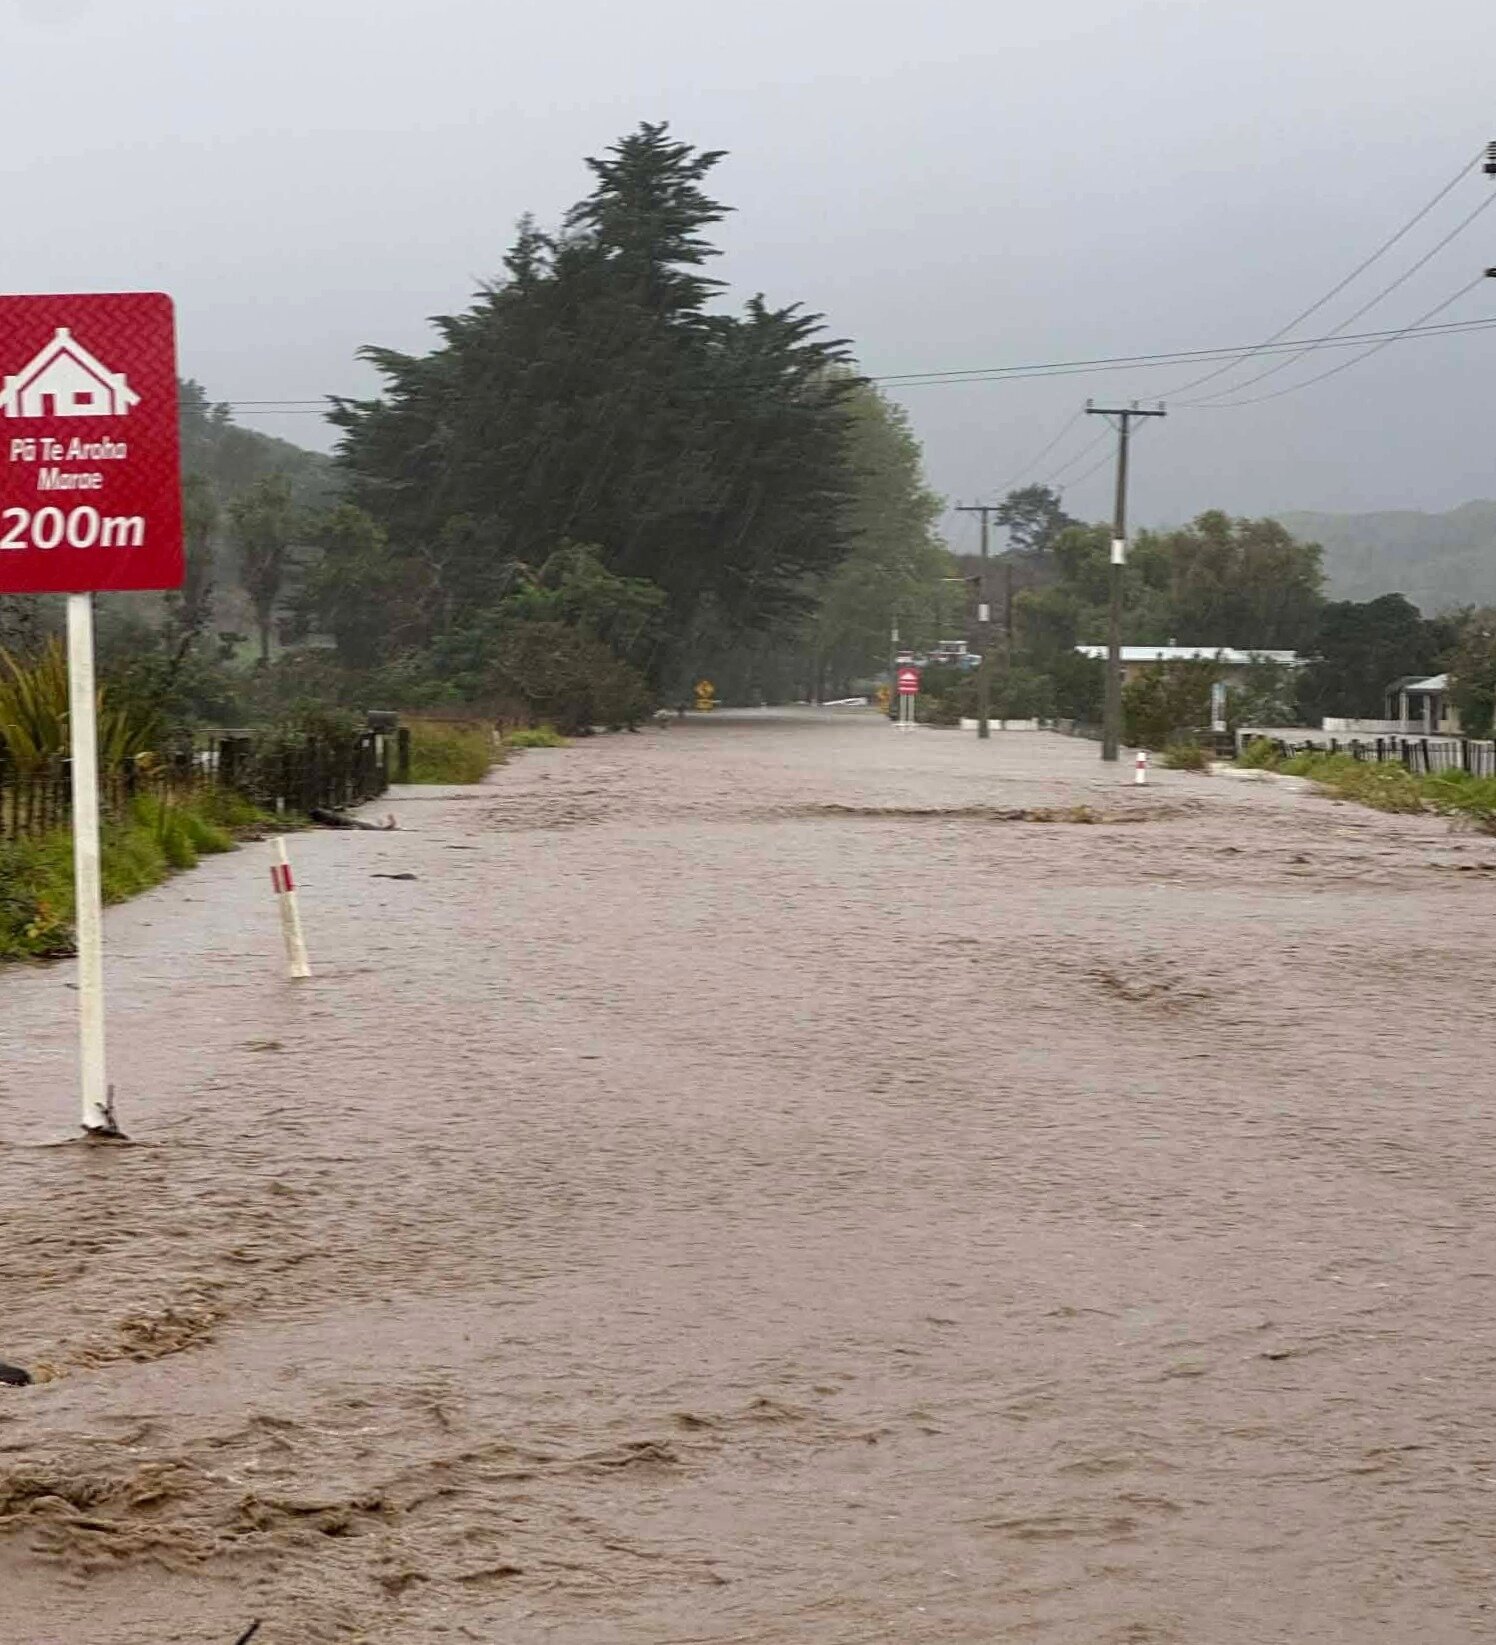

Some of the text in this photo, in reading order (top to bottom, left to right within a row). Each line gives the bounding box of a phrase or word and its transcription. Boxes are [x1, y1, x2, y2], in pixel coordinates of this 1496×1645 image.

[39, 437, 64, 460] Te
[65, 436, 127, 460] Aroha
[37, 467, 103, 490] Marae
[0, 505, 145, 549] 200m
